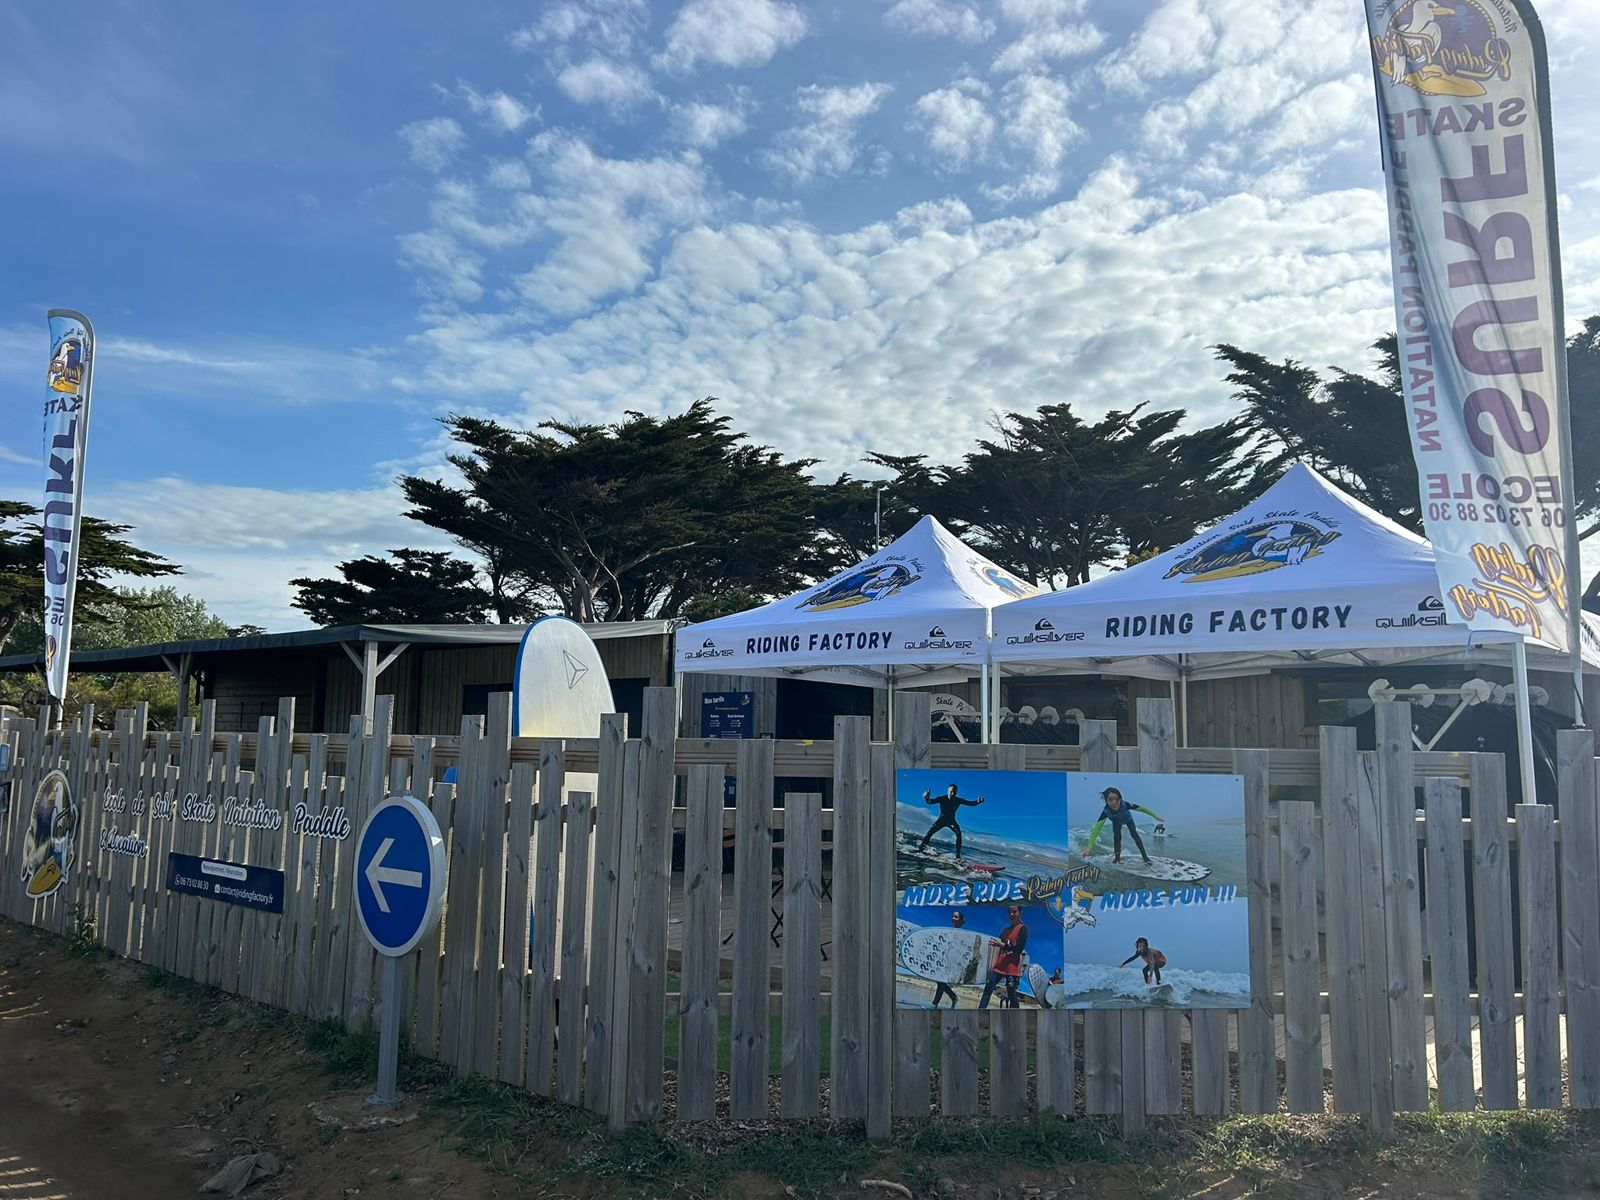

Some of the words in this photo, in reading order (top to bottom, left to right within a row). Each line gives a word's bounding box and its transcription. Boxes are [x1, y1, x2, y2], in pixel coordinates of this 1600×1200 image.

[1264, 509, 1299, 520] Skate
[1105, 612, 1194, 638] RIDING
[1209, 604, 1352, 633] FACTORY
[746, 635, 800, 654] RIDING
[808, 631, 893, 651] FACTORY
[904, 638, 973, 650] QUIKSILVER
[1006, 631, 1085, 645] QUIKSILVER
[684, 648, 734, 659] QUIKSILVER
[935, 696, 953, 706] Skate
[131, 790, 146, 816] de
[152, 788, 176, 821] Surf
[181, 792, 216, 822] Skate
[224, 795, 281, 830] Natation
[292, 802, 350, 840] Paddle
[903, 881, 969, 907] MORE
[972, 879, 1024, 903] RIDE
[1027, 874, 1064, 900] Riding
[1063, 863, 1100, 888] Factory
[1101, 887, 1166, 912] MORE
[1168, 886, 1211, 907] FUN
[1213, 882, 1237, 904] !!!
